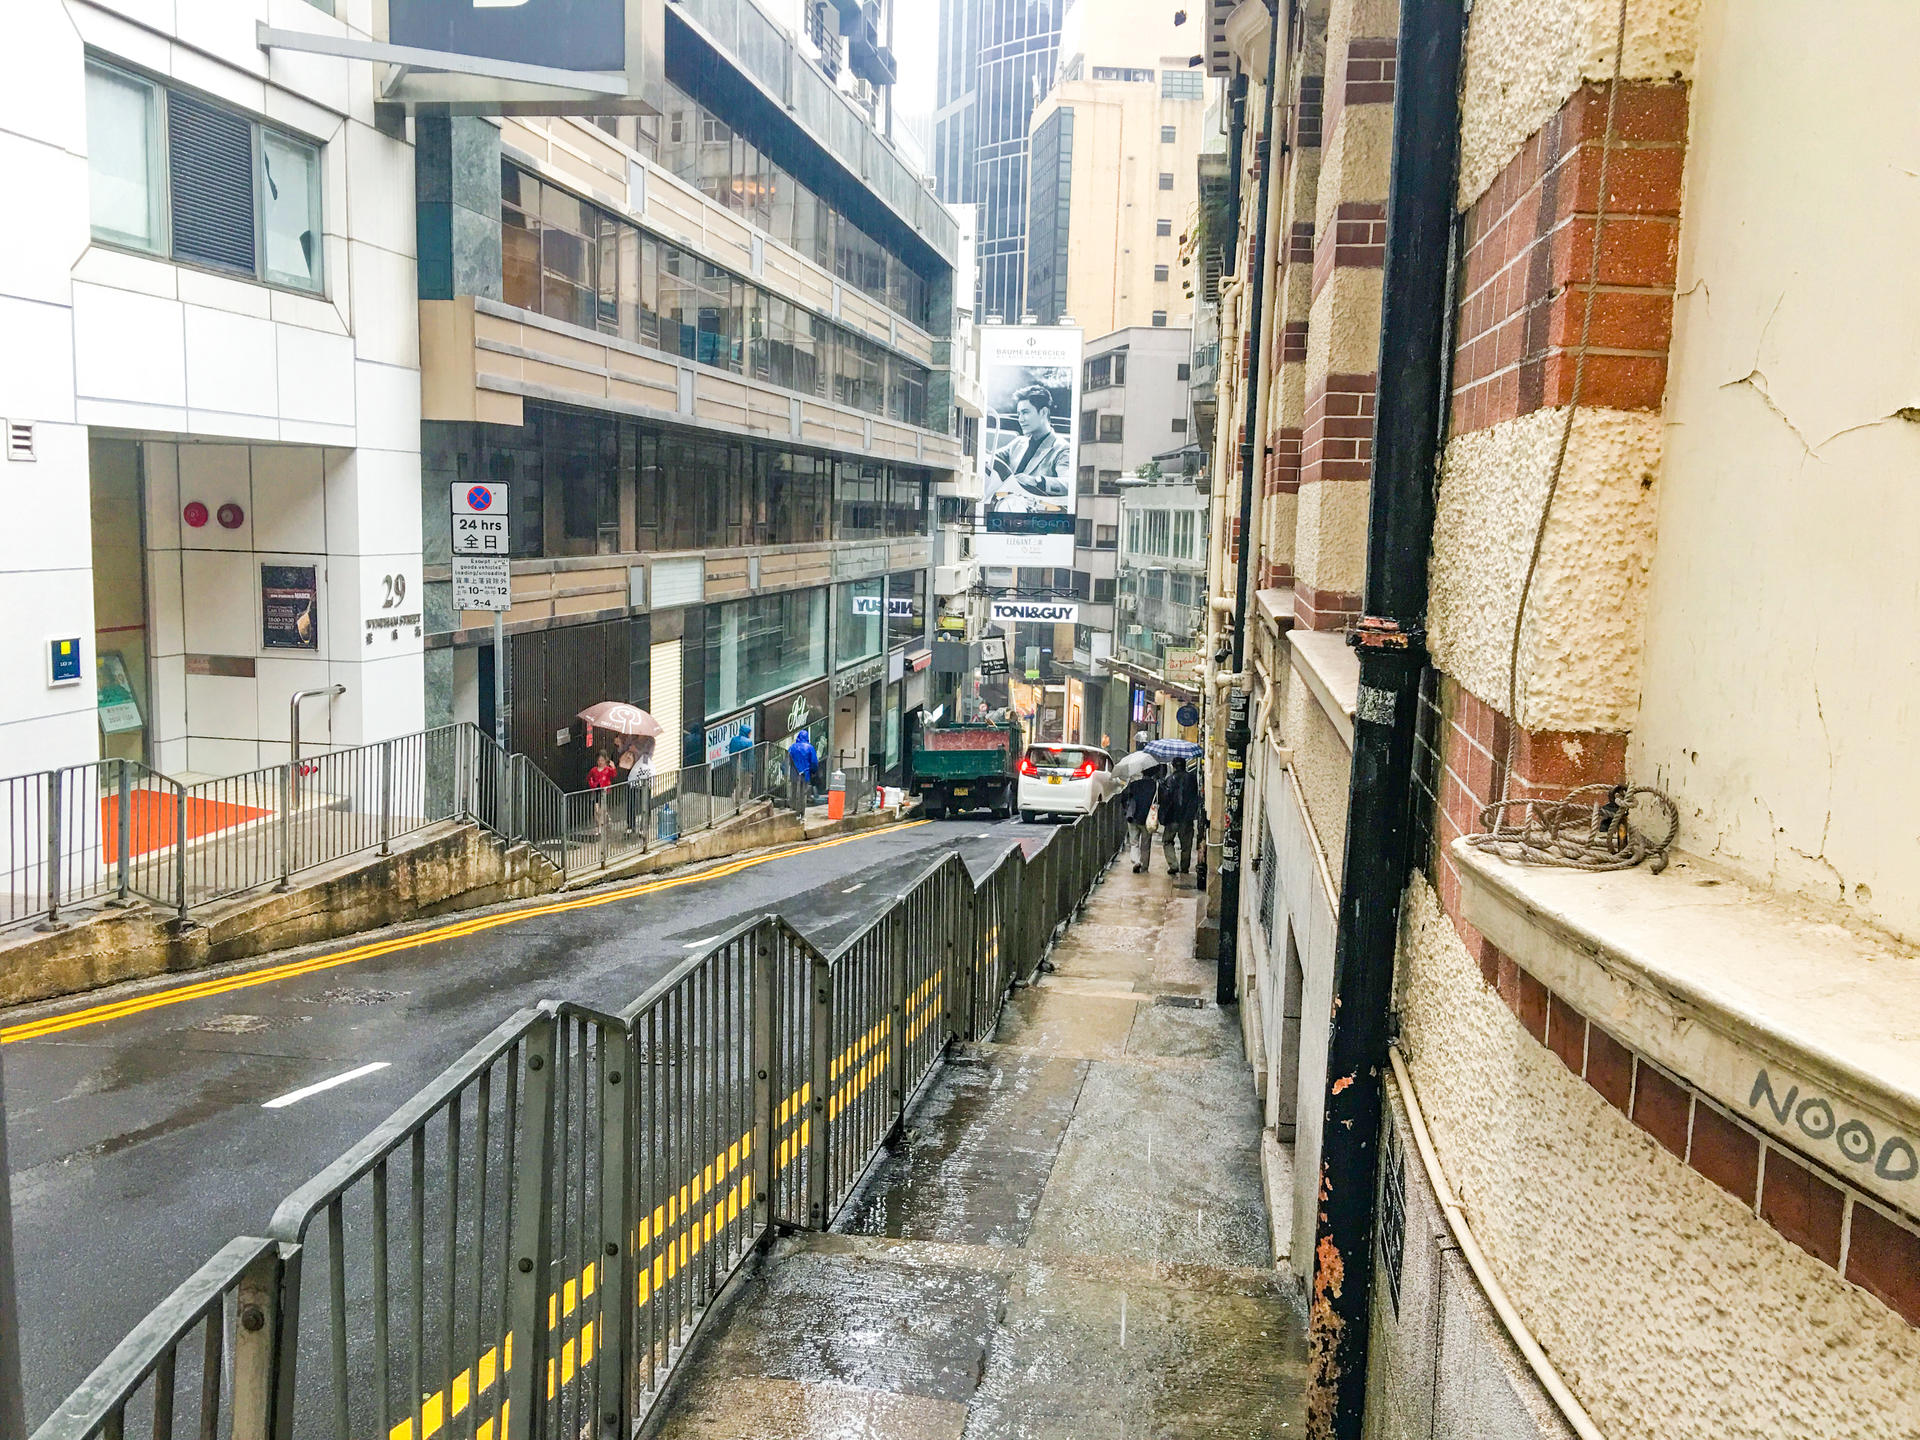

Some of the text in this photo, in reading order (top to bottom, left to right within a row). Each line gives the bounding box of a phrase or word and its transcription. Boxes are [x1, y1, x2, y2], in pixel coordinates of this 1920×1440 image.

[459, 519, 502, 531] 24 hrs
[463, 534, 497, 549] 全日
[382, 574, 406, 608] 29
[497, 587, 508, 595] 12
[993, 605, 1073, 620] TONI&GUY
[708, 725, 728, 748] SHOP
[729, 721, 739, 738] TO
